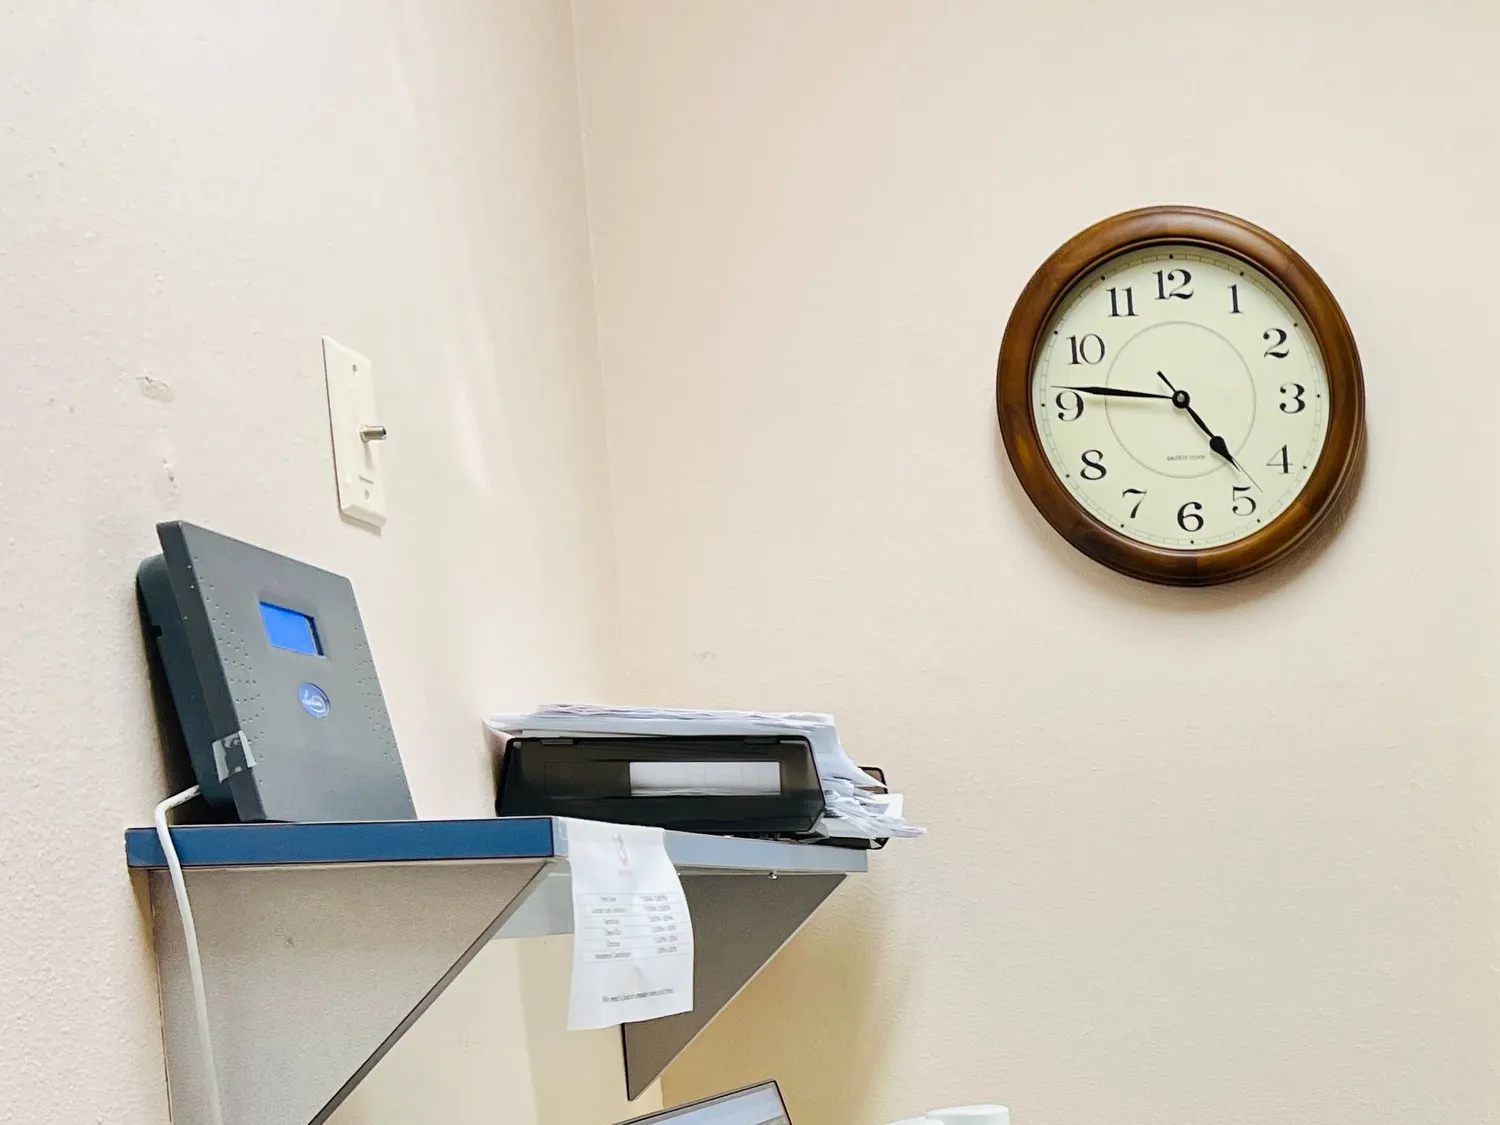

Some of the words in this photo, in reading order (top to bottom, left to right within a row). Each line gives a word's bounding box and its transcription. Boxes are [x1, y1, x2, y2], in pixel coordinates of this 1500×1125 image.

[1153, 269, 1193, 299] 12
[1228, 284, 1242, 314] 1
[1106, 286, 1138, 317] 11
[1066, 334, 1105, 365] 10
[1263, 328, 1289, 358] 2
[1056, 393, 1084, 421] 9
[1279, 384, 1305, 414] 3
[1080, 450, 1106, 480] 8
[1267, 445, 1293, 474] 4
[1123, 489, 1147, 518] 7
[1232, 486, 1256, 515] 5
[1177, 502, 1204, 532] 6
